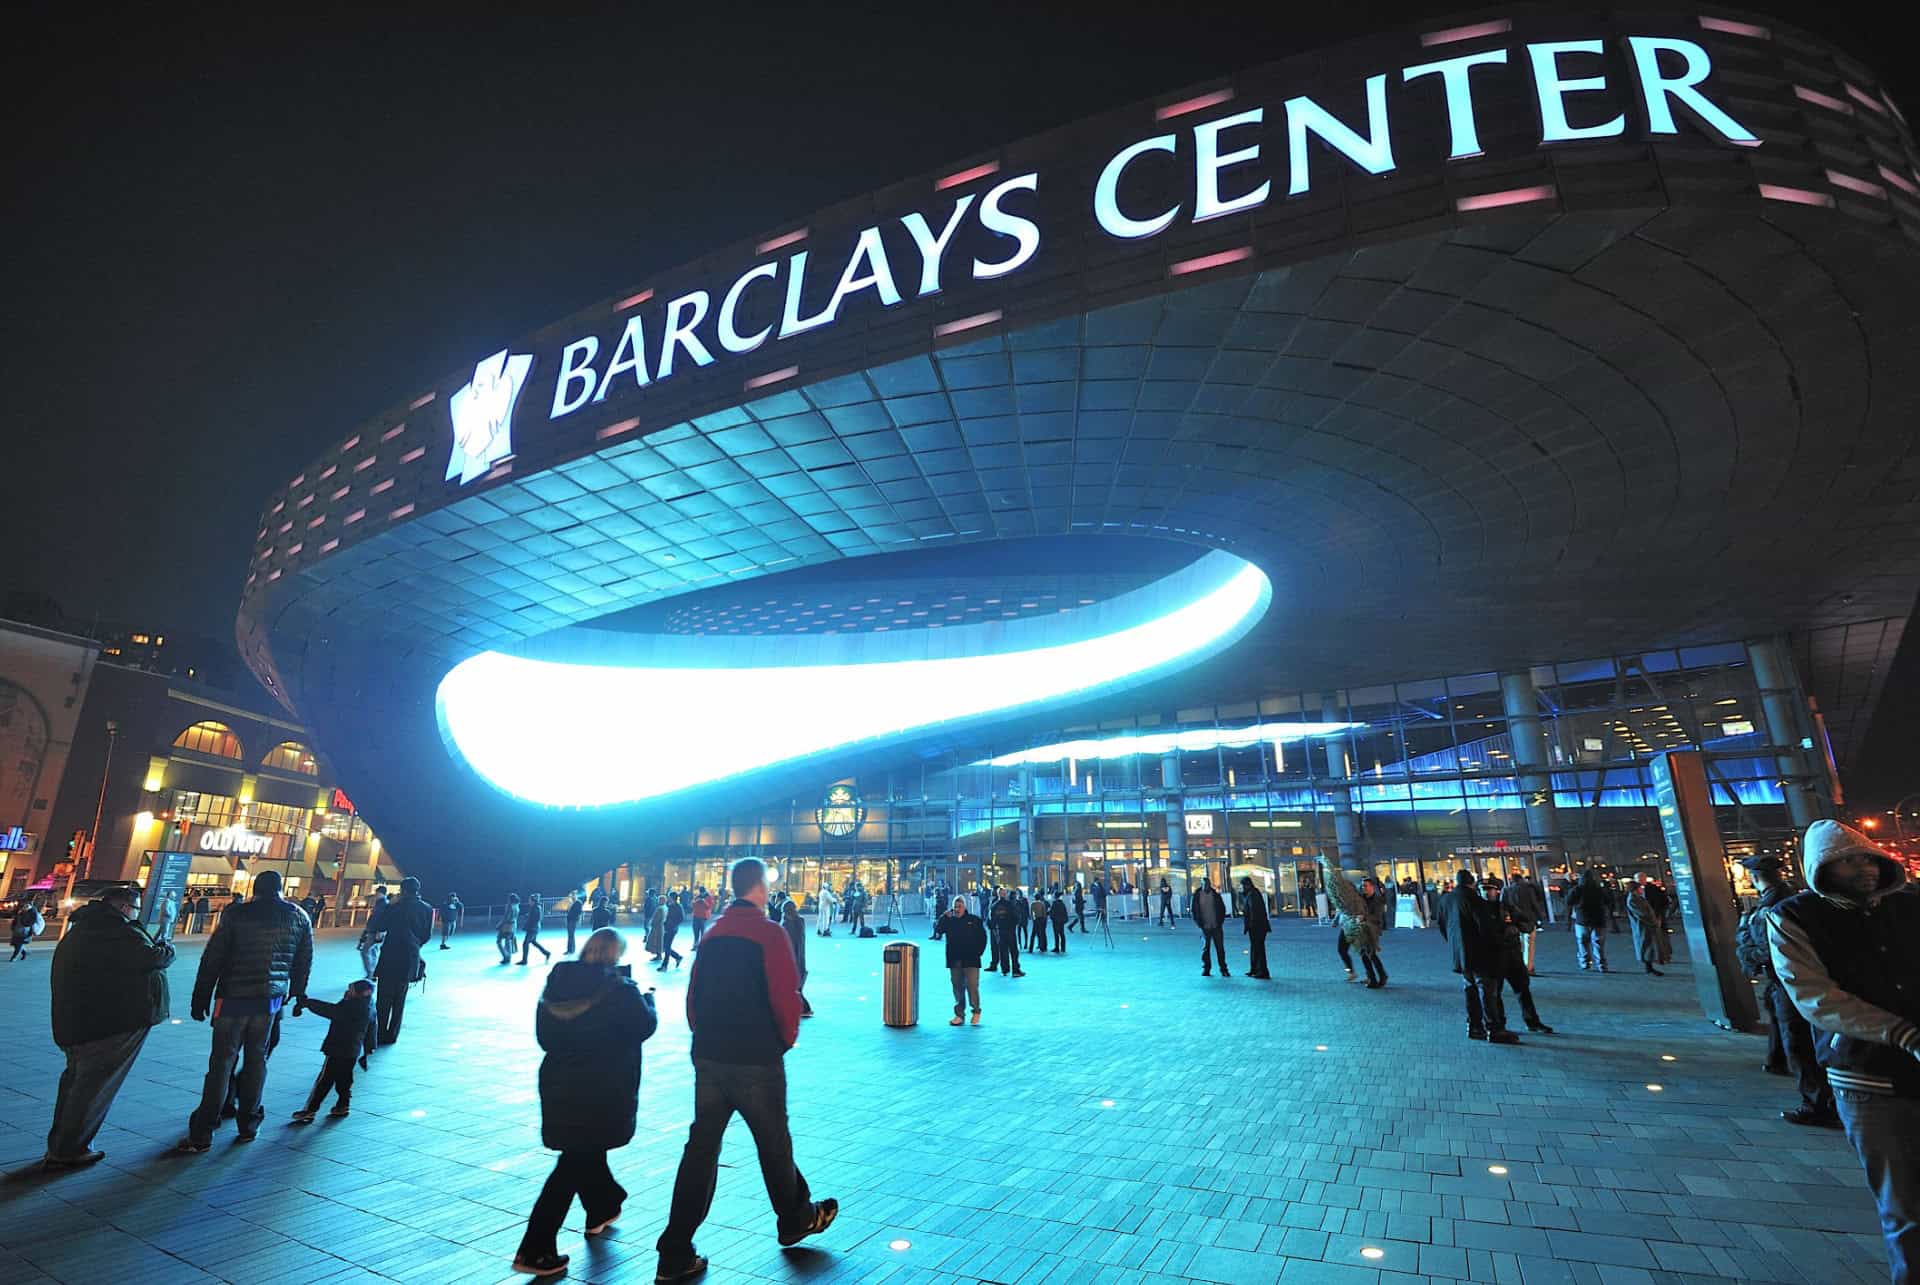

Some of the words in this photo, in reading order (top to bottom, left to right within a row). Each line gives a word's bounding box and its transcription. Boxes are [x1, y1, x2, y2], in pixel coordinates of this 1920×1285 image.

[549, 172, 1041, 420] BARCLAYS
[1094, 35, 1762, 239] CENTER
[200, 829, 231, 851] OLD
[232, 831, 273, 855] NAVY
